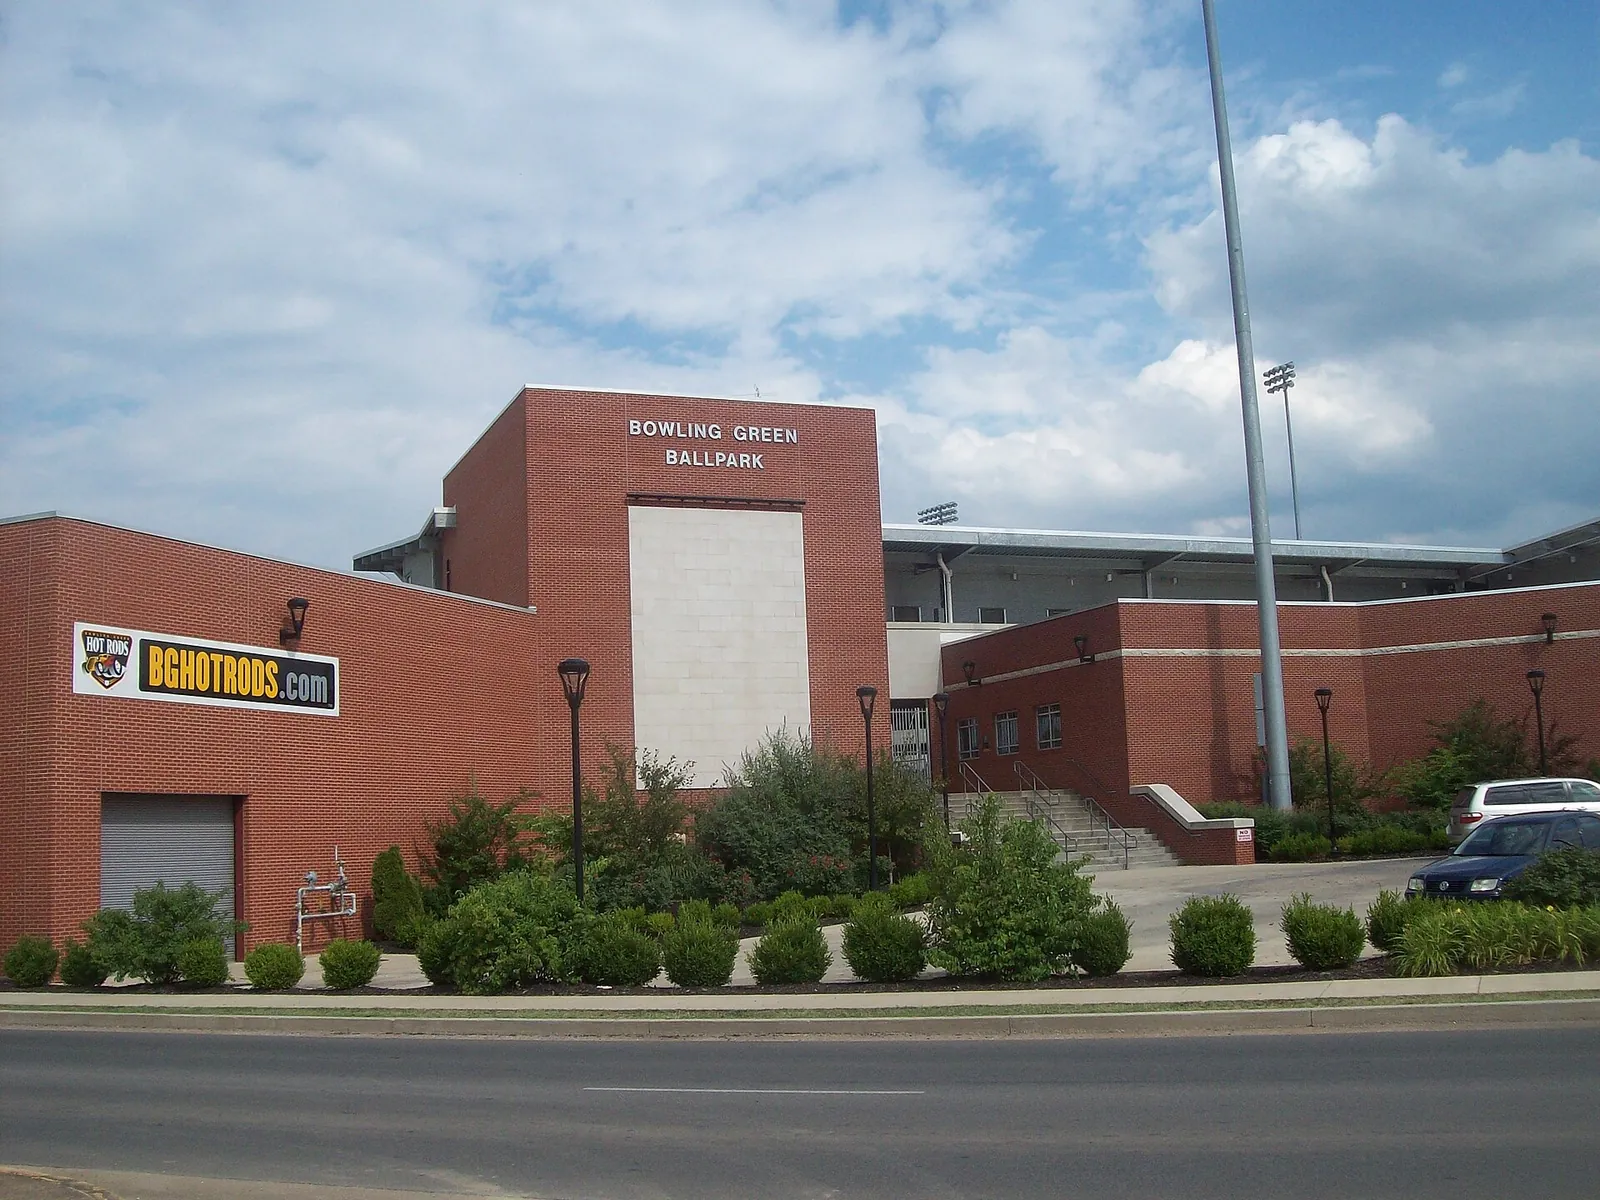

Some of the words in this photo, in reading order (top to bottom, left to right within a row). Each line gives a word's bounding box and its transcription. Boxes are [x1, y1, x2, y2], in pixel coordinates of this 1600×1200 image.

[629, 420, 722, 440] BOWLING
[733, 425, 798, 444] GREEN
[665, 449, 764, 469] BALLPARK
[86, 636, 105, 653] HOT
[106, 638, 129, 656] RODS
[148, 645, 328, 704] BGHOTRODS.com
